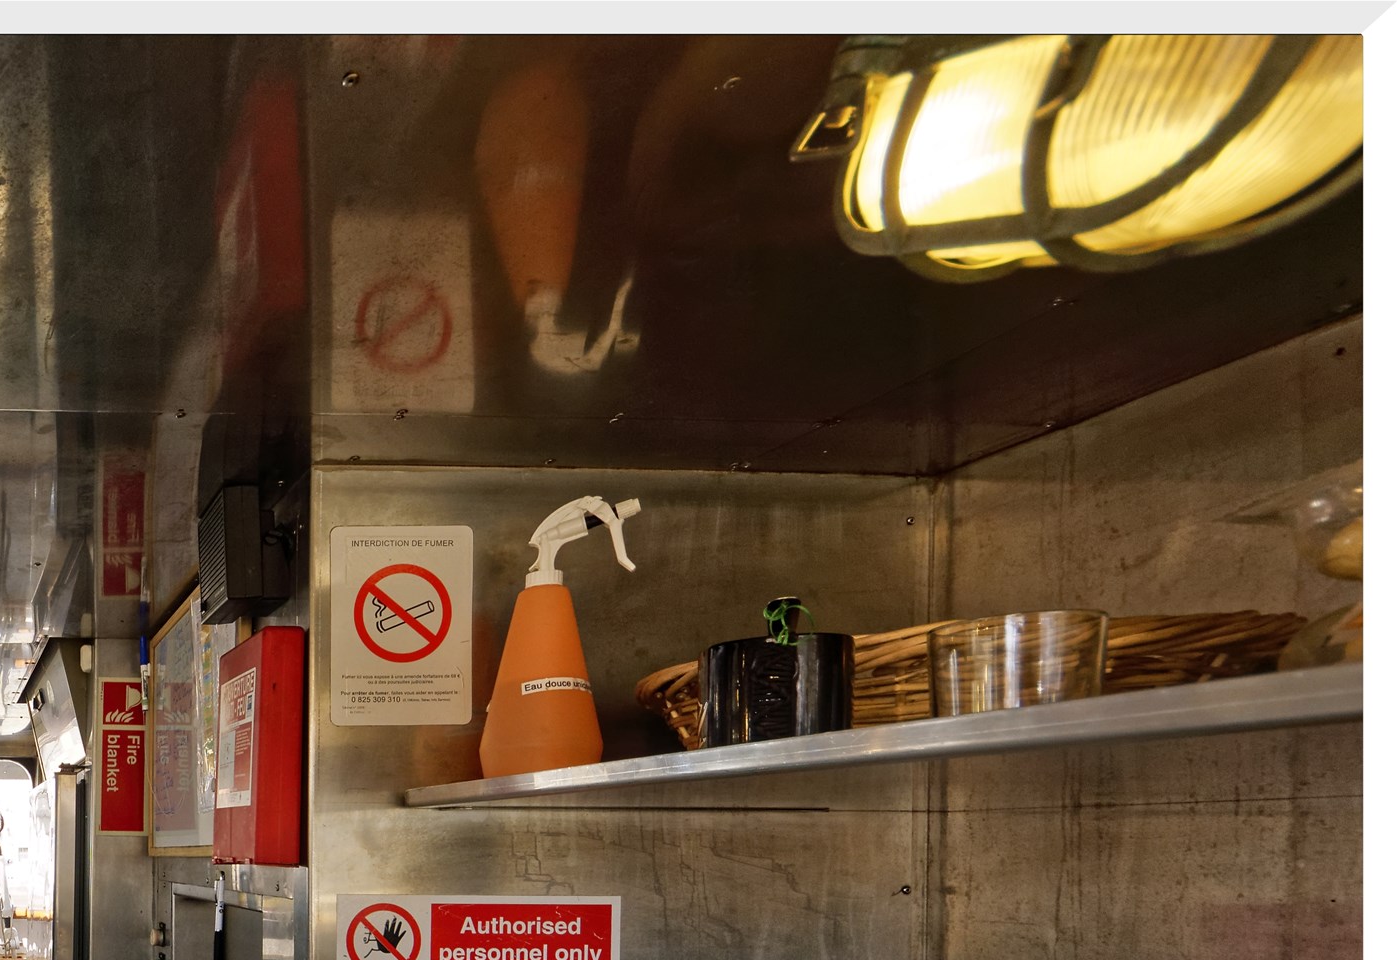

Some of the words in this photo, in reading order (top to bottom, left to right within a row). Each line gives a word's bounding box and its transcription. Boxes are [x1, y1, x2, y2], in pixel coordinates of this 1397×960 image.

[351, 539, 410, 547] INTERDICTION
[411, 539, 423, 547] DE
[424, 539, 454, 547] FUMER
[524, 683, 543, 691] Eau
[545, 680, 572, 688] douce
[126, 735, 141, 765] Fire
[106, 734, 121, 792] blanket
[460, 916, 581, 934] Authorised
